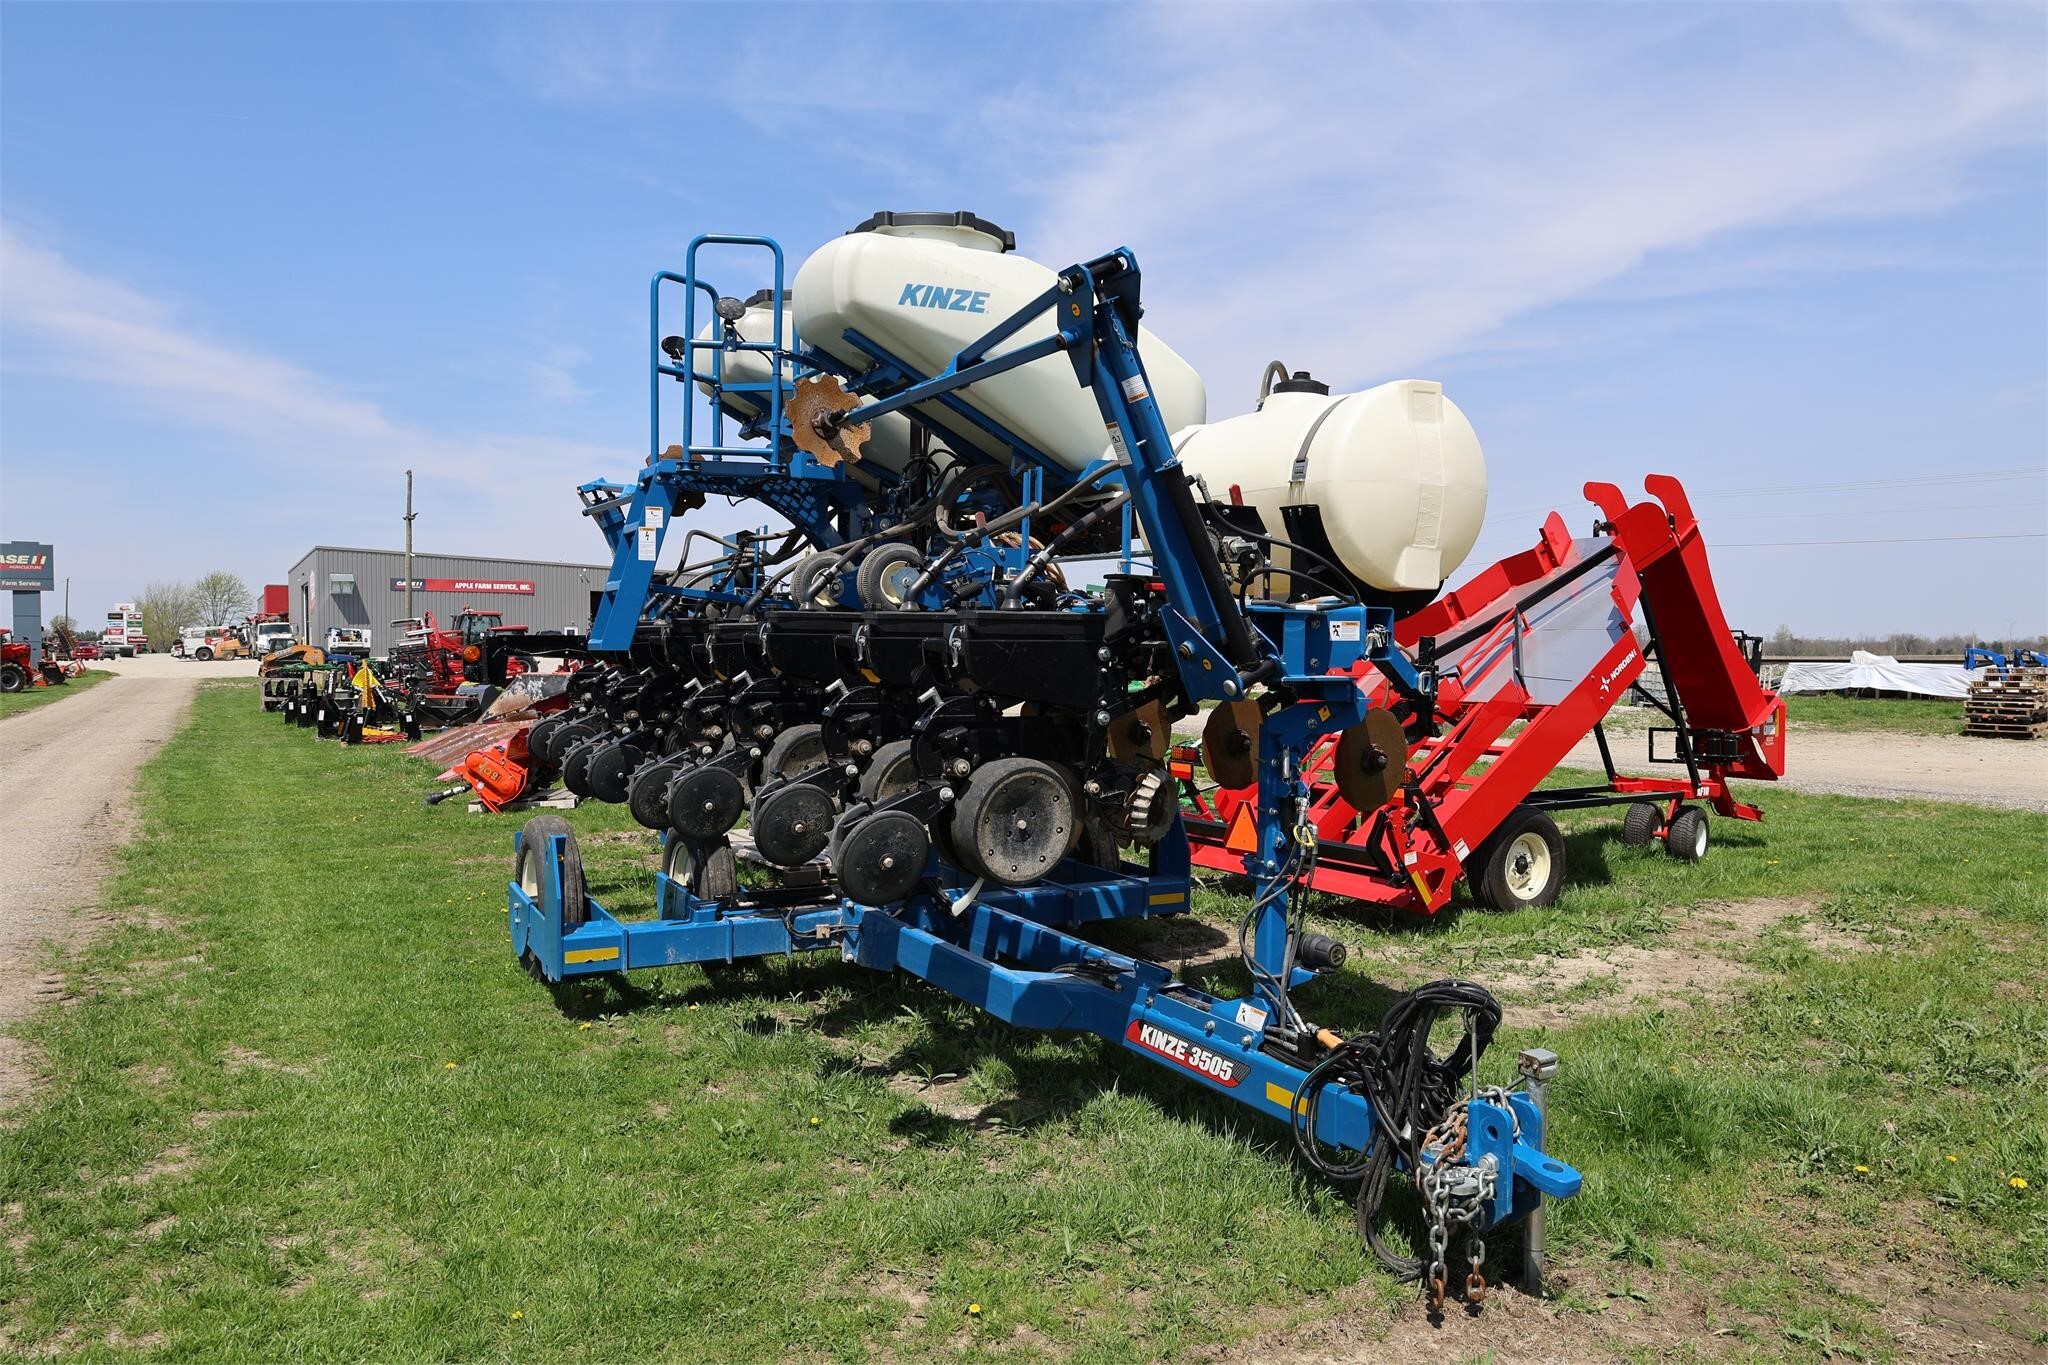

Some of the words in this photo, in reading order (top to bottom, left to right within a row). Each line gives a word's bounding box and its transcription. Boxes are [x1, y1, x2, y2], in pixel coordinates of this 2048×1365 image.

[898, 283, 991, 314] KINZE
[0, 554, 30, 564] ASE
[1139, 1023, 1190, 1061] KINZE
[1188, 1046, 1235, 1081] 3505
